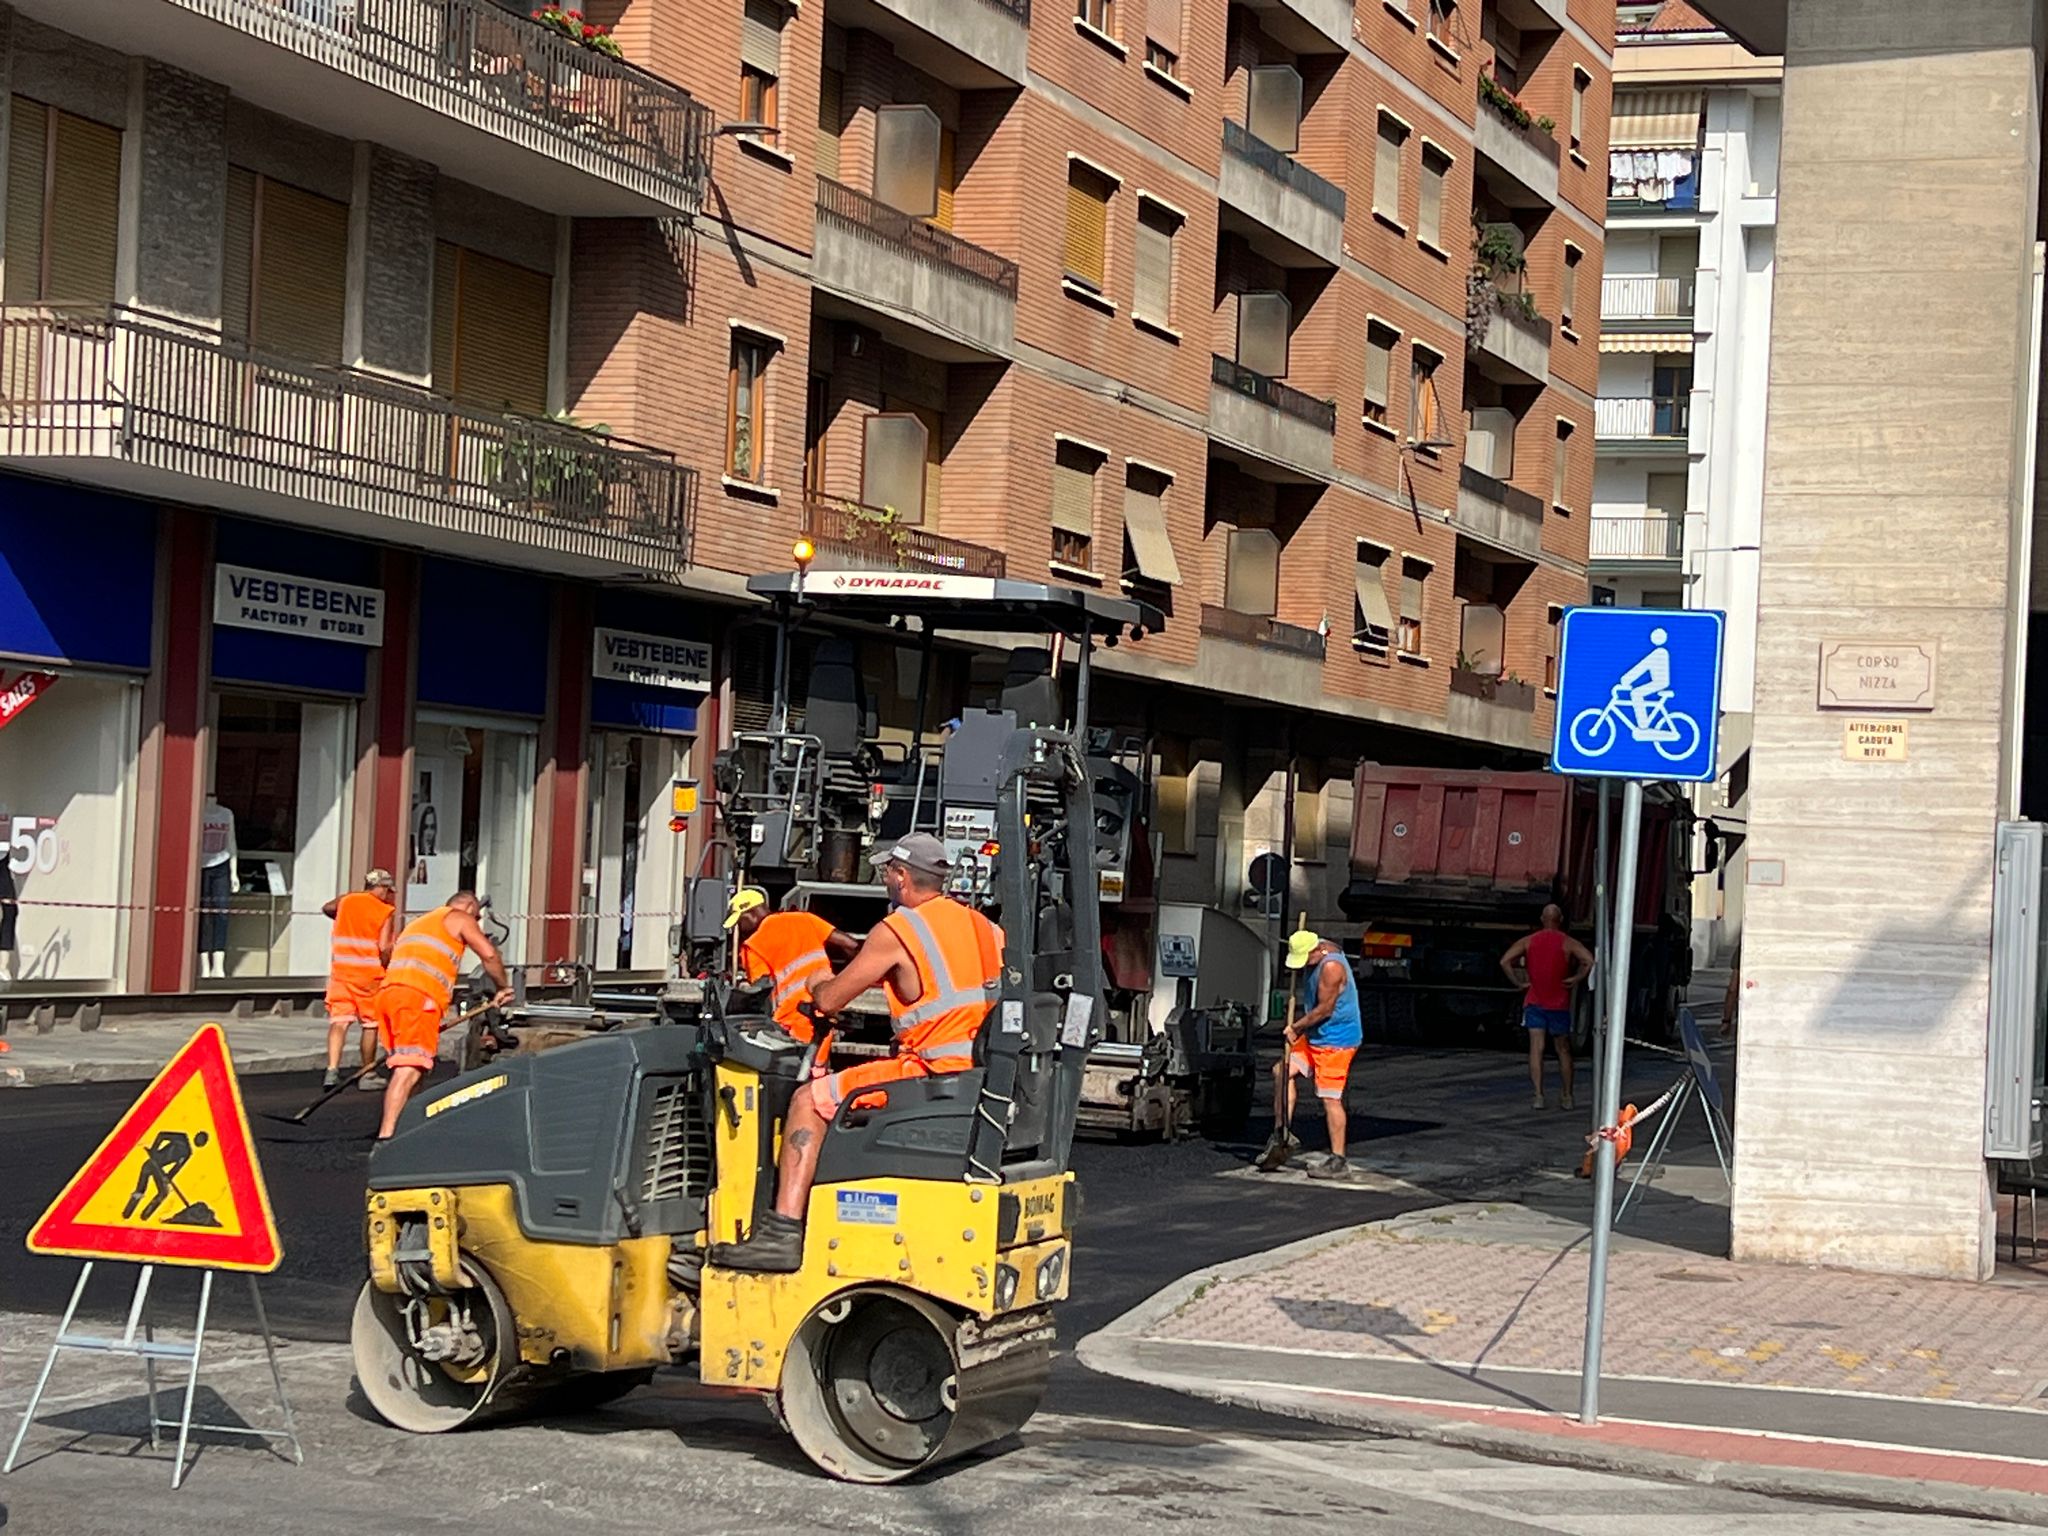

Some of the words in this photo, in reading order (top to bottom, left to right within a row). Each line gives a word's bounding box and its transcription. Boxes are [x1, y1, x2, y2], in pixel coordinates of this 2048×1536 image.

[229, 574, 377, 618] VESTEBENE
[848, 577, 945, 590] DYNAPAC
[241, 606, 308, 627] FACTORY
[320, 618, 365, 636] STORE
[604, 634, 708, 669] VESTEBENE
[1857, 656, 1899, 668] CORSO
[0, 674, 35, 717] SALES
[1859, 676, 1896, 689] NIZZA
